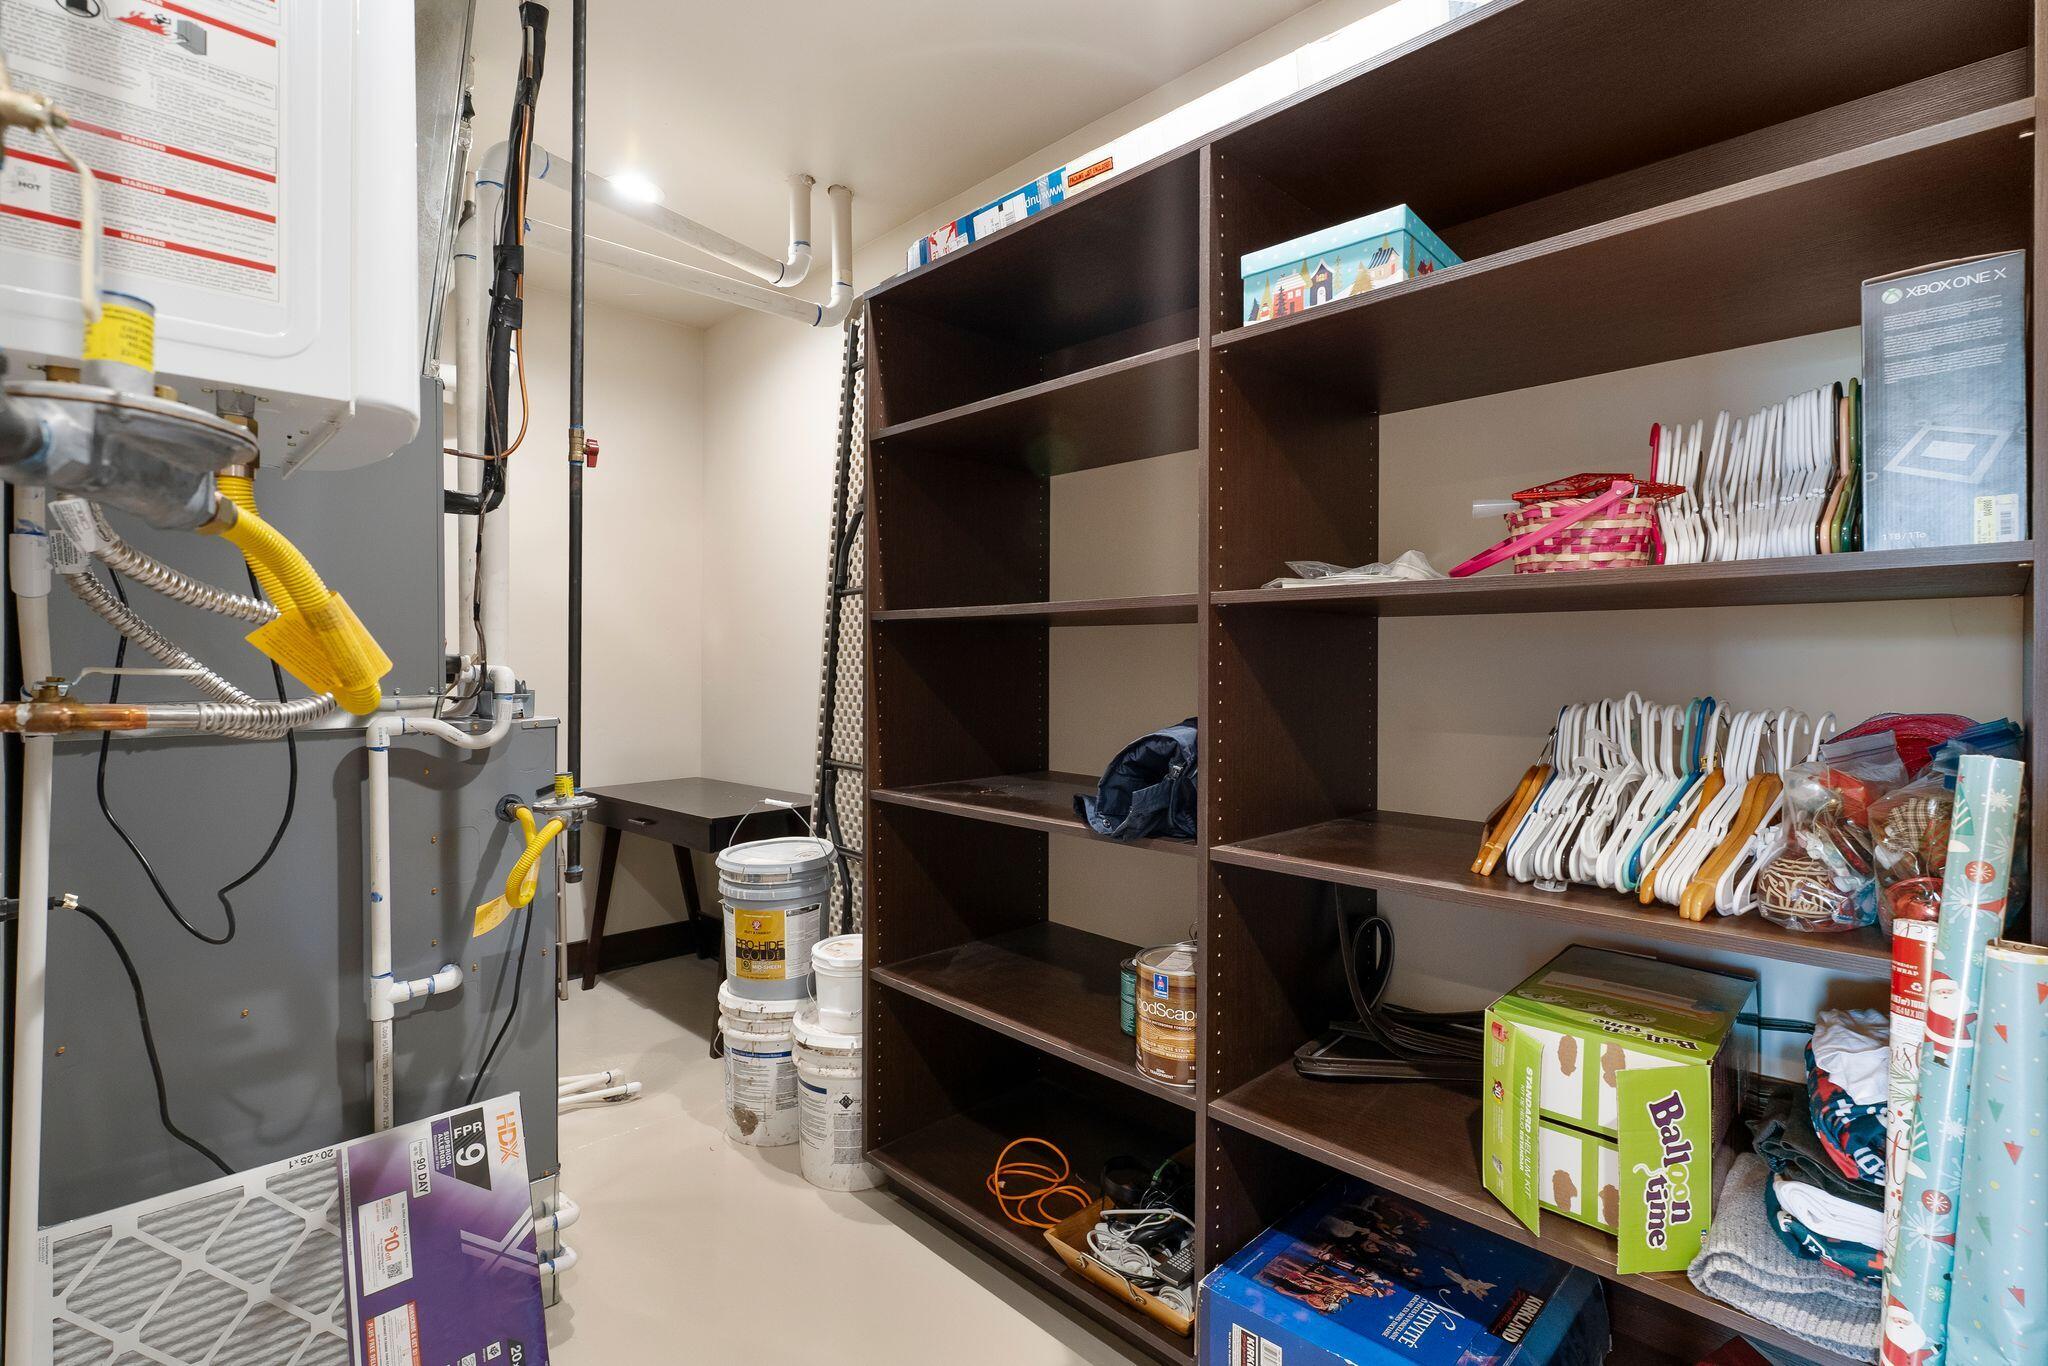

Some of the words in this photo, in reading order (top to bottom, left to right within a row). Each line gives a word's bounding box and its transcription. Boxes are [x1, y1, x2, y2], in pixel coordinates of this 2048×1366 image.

[120, 133, 167, 152] WARNING
[120, 176, 167, 196] WARNING
[120, 230, 167, 248] WARNING
[1906, 278, 1952, 298] XBOX
[1953, 270, 1991, 288] ONE
[1994, 266, 2007, 280] X
[735, 938, 784, 950] PRO-HIDE
[1525, 1066, 1533, 1133] STANDARD
[453, 1121, 482, 1139] FPR
[496, 1112, 520, 1164] HDX
[416, 1158, 426, 1171] 90
[437, 1133, 445, 1169] ALLERGEN
[443, 1131, 451, 1166] SUPERIOR
[455, 1143, 485, 1166] 9
[1524, 1134, 1532, 1178] HELIUM
[1650, 1090, 1693, 1225] Balloon
[418, 1174, 428, 1193] DAY
[1645, 1173, 1668, 1249] time
[1501, 1295, 1544, 1343] KIRKLAND
